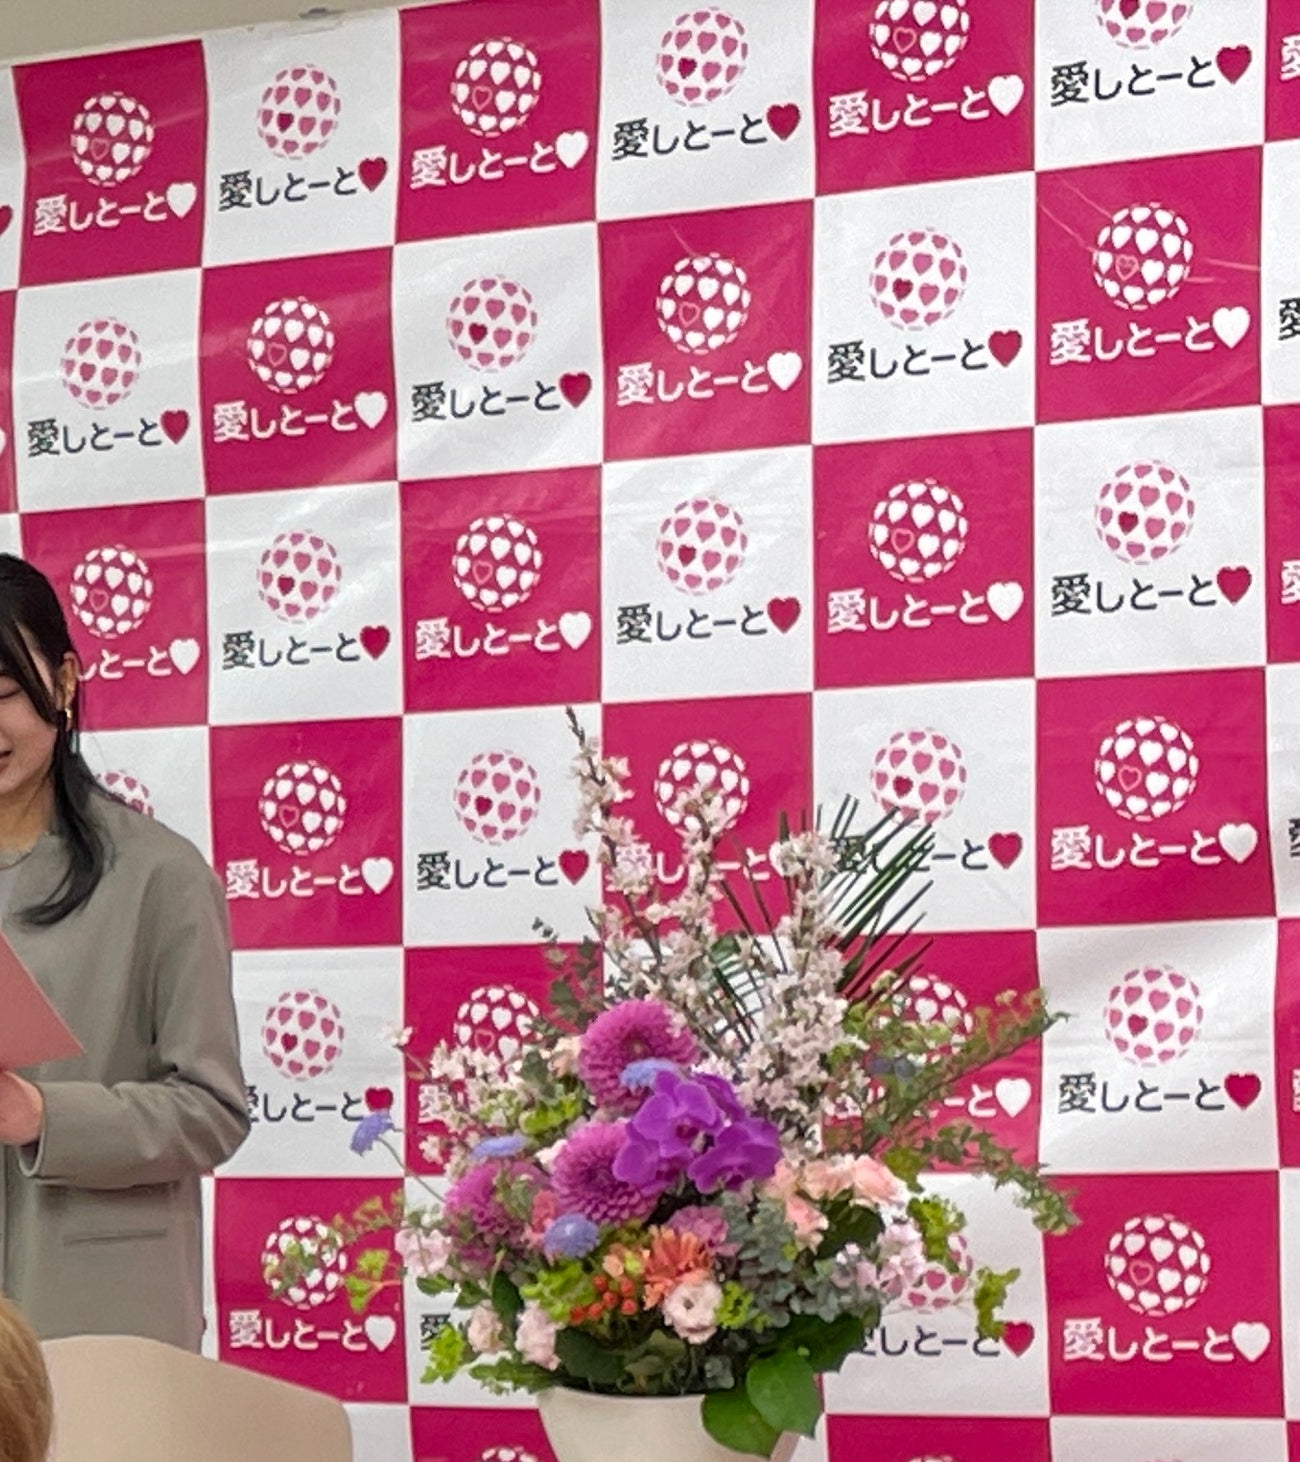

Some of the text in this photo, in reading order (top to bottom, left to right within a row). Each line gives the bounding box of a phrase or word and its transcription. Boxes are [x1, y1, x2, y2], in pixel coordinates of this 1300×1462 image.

[1051, 56, 1217, 106] 愛しとーと
[829, 86, 990, 138] 愛しとーと
[612, 112, 767, 160] 愛しとーと
[219, 166, 357, 210] 愛しとーと
[410, 144, 557, 189] 愛しとーと
[34, 195, 168, 235] 愛しとーと
[828, 338, 988, 383] 愛しとーと
[1051, 316, 1215, 366] 愛しとーと
[412, 381, 560, 422] 愛しとーと
[617, 360, 769, 406] 愛しとーと
[28, 418, 161, 455] 愛しとーと
[213, 400, 356, 443] 愛しとーと
[827, 585, 988, 634] 愛しとーと
[1051, 573, 1217, 618] 愛しとーと
[415, 617, 560, 660] 愛しとーと
[616, 603, 767, 644] 愛しとーと
[78, 648, 172, 682] とーと
[222, 630, 360, 671] 愛しとーと
[1050, 825, 1222, 870] 愛しとーと
[225, 858, 363, 900] 愛しとーと
[416, 851, 559, 892] 愛しとーと
[1058, 1072, 1225, 1115] 愛しとーと
[230, 1310, 366, 1350] 愛しとーと
[864, 1325, 1000, 1356] しとーと
[1063, 1317, 1234, 1364] 愛しとーと
